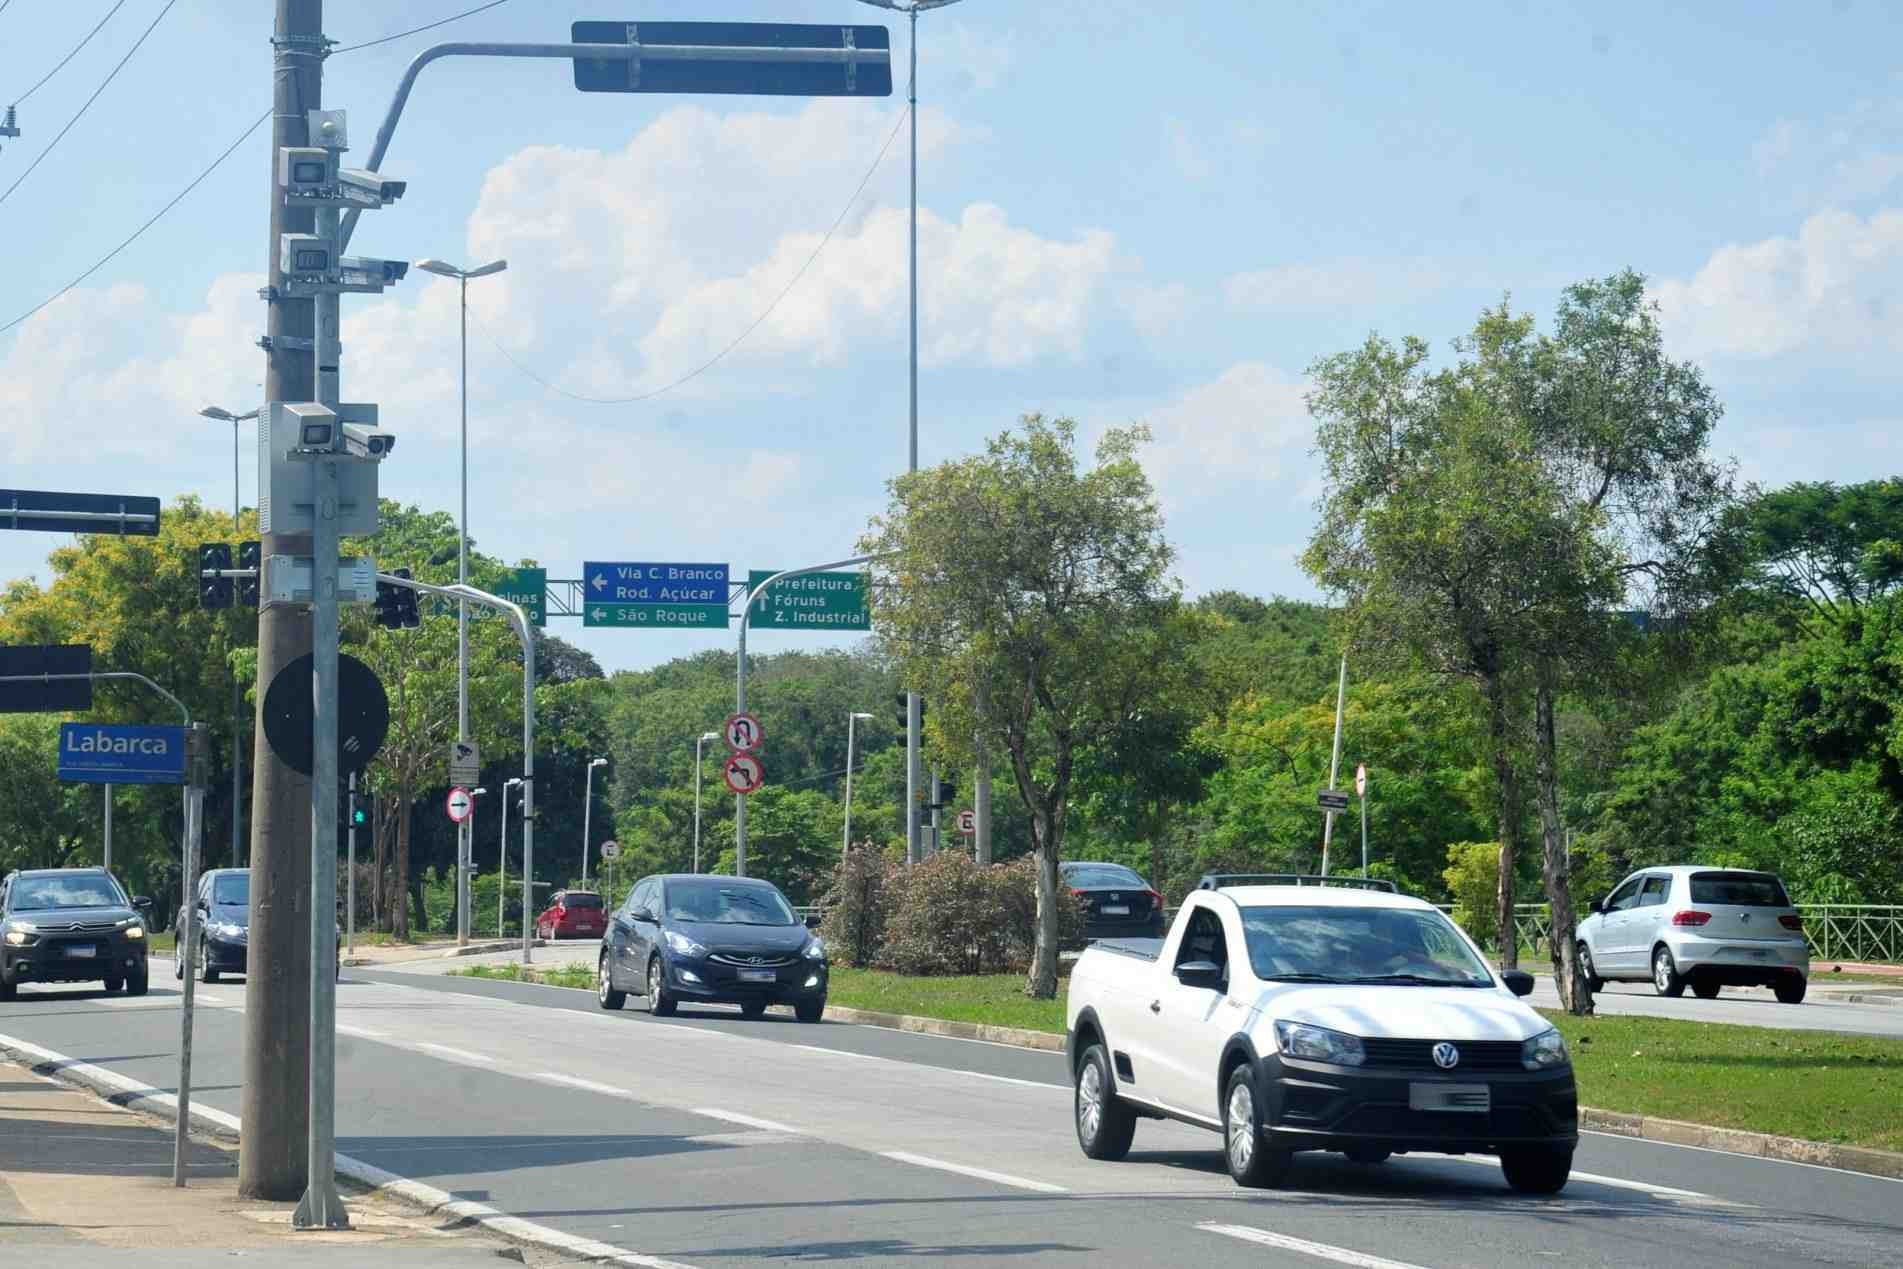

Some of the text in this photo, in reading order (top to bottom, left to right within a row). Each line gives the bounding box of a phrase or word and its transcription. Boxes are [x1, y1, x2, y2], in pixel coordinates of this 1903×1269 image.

[617, 567, 725, 581] Via C. Branco
[616, 586, 716, 603] Rod. Açúcar
[775, 593, 826, 607] Fóruns
[617, 608, 708, 624] São Roque
[775, 610, 789, 623] Z.
[67, 730, 168, 755] Labarca
